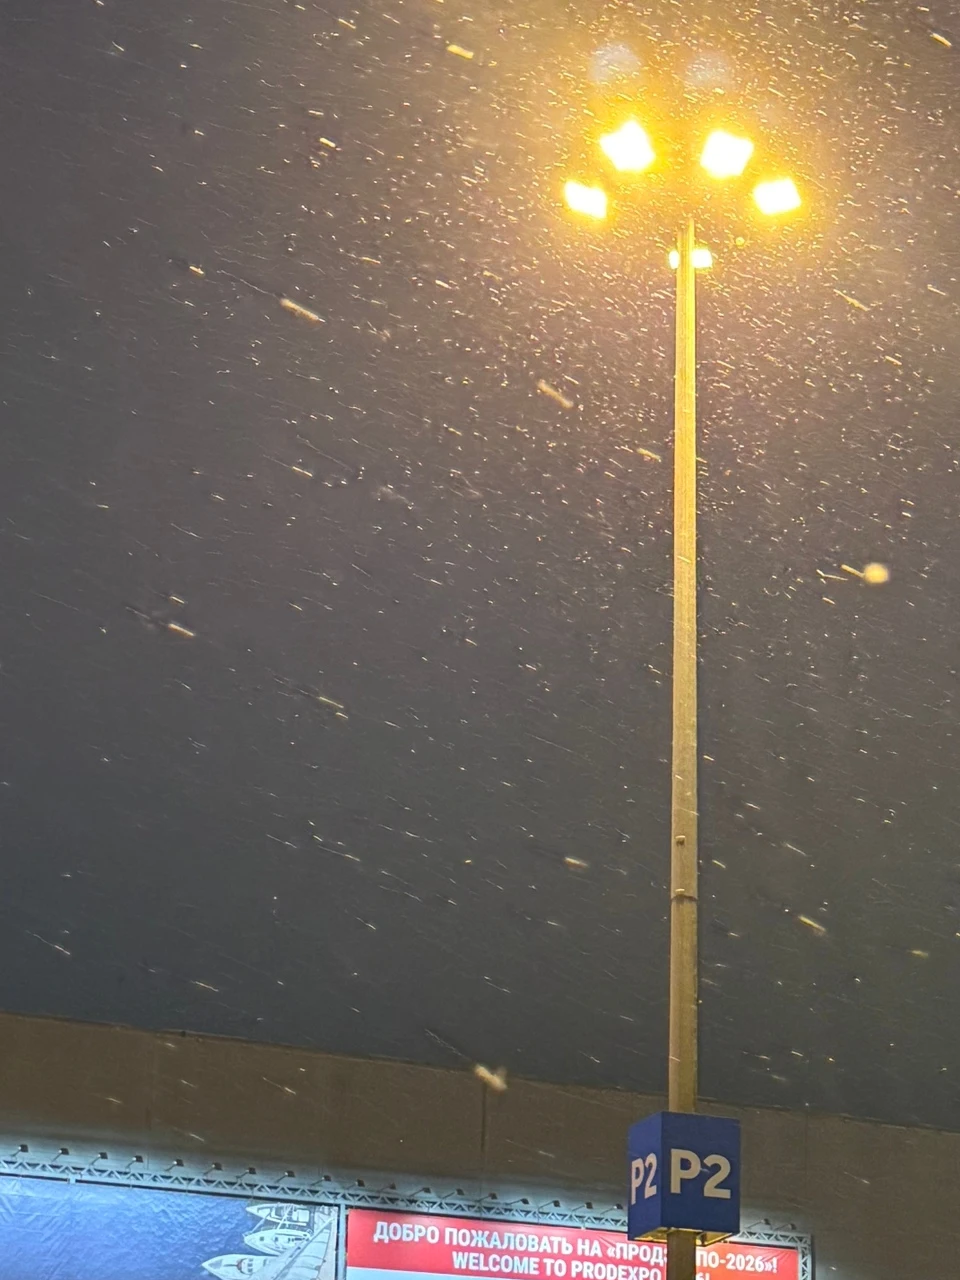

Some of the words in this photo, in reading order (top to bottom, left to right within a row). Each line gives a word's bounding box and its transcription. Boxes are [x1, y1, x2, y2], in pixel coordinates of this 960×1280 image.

[631, 1153, 657, 1205] P2
[671, 1148, 731, 1199] P2
[373, 1221, 439, 1244] ДОБРО
[445, 1228, 573, 1255] ПОЖАЛОВАТЬ
[577, 1238, 602, 1258] НА
[452, 1251, 539, 1275] WELCOME
[543, 1258, 567, 1277] TO
